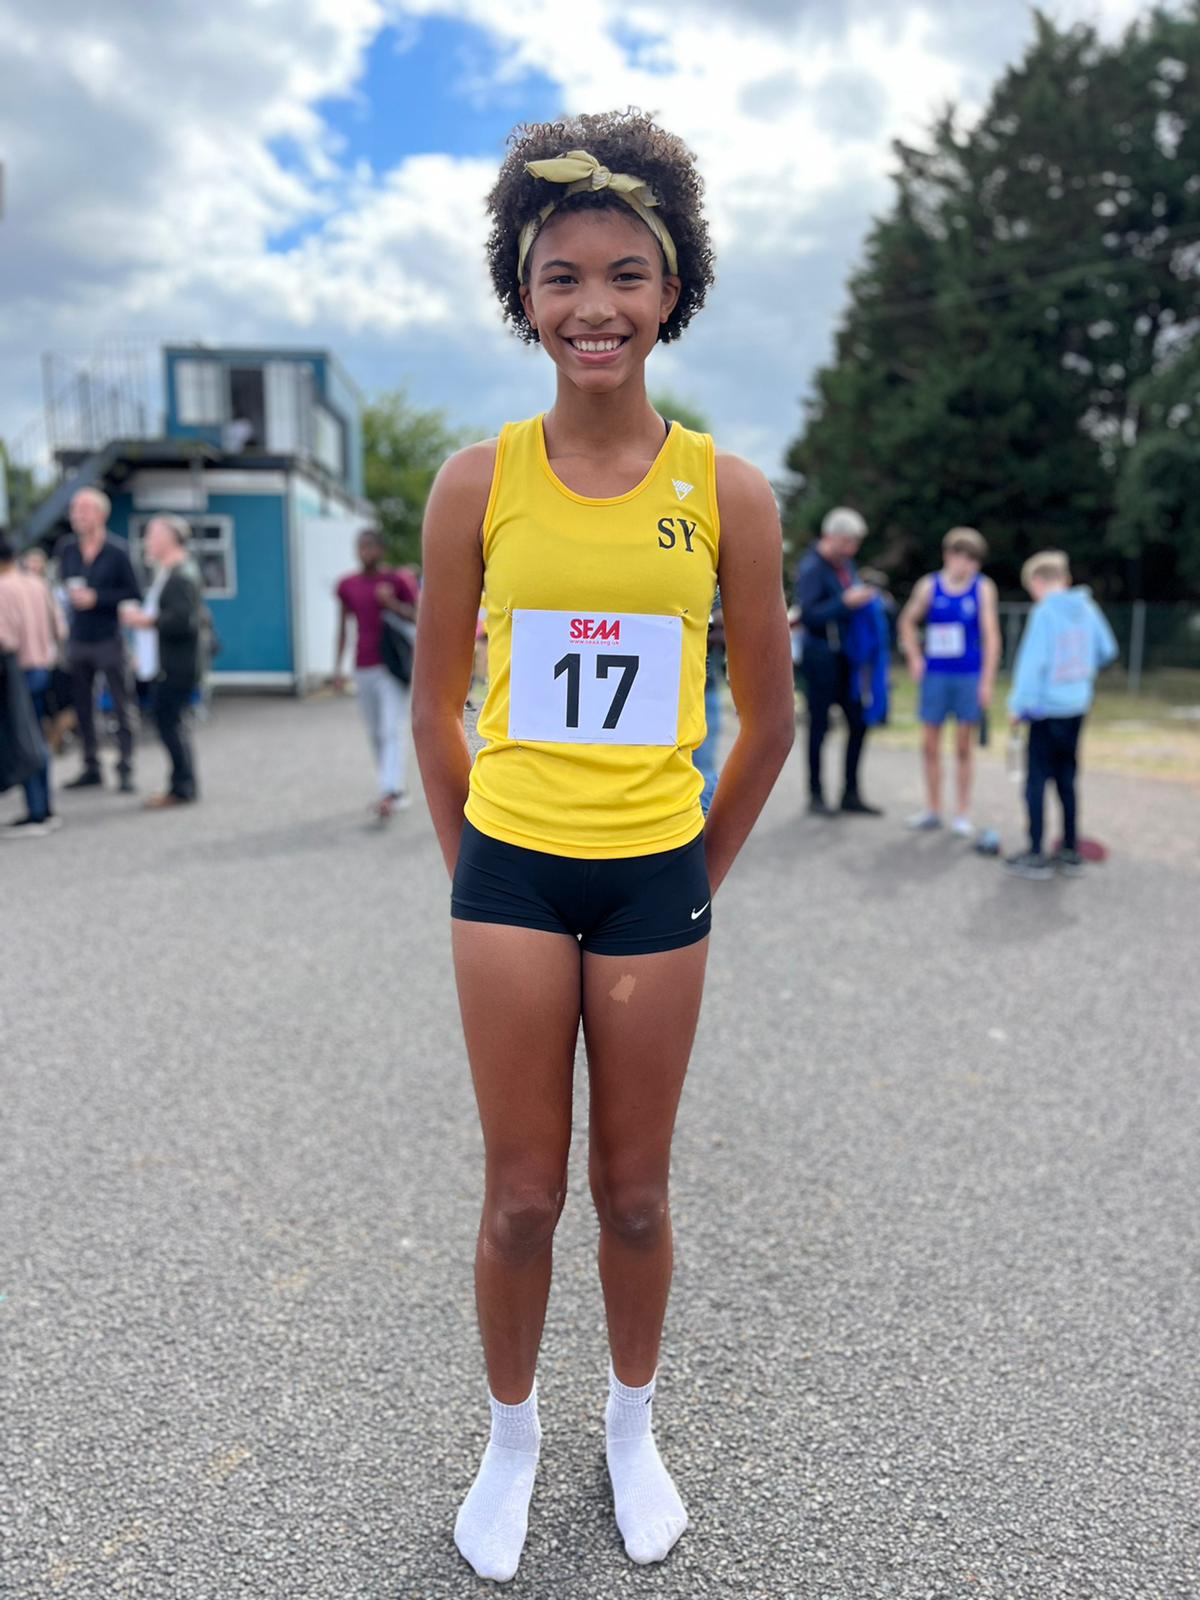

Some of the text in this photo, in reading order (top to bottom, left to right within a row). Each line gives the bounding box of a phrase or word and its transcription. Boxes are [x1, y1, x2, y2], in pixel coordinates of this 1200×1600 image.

[657, 517, 697, 553] SY
[569, 618, 621, 640] SEAA
[553, 653, 640, 729] 17
